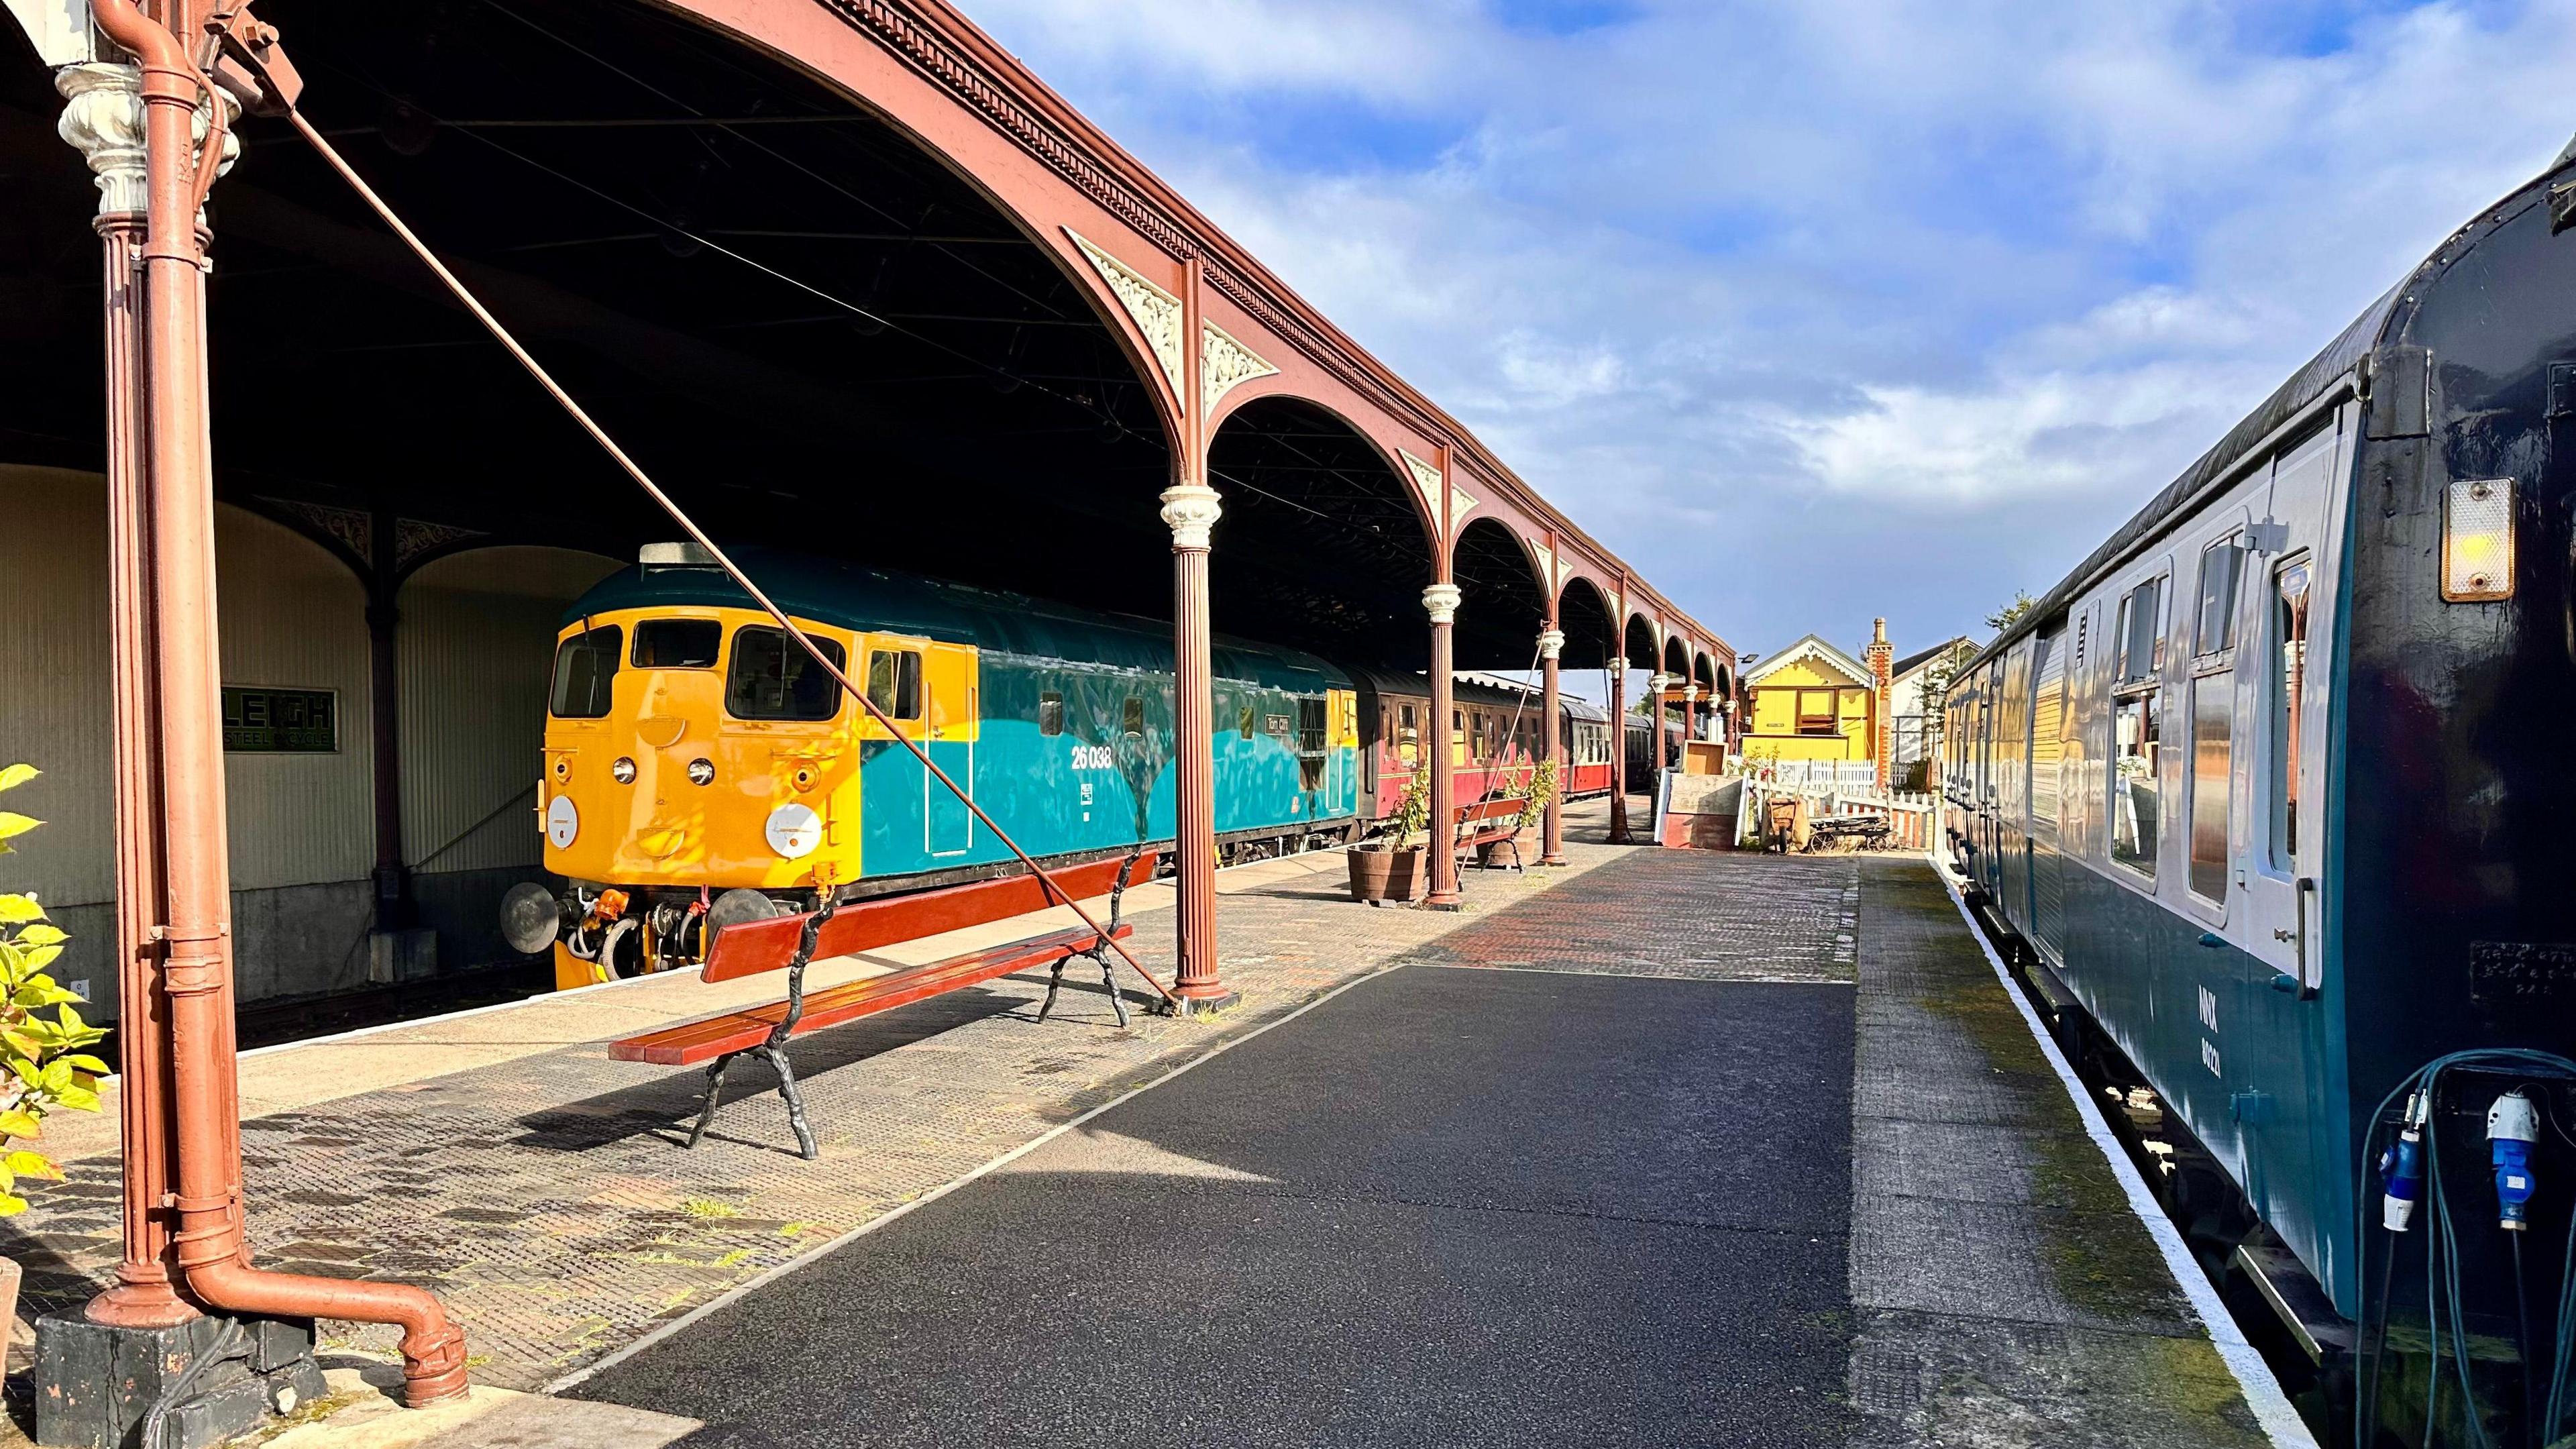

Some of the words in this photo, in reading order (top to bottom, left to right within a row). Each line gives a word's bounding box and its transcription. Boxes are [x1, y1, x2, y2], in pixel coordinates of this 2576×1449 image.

[223, 732, 269, 745] STEEL
[273, 733, 329, 746] BCYCLE
[2199, 984, 2218, 1033] NNX
[2202, 1037, 2221, 1079] 80221
